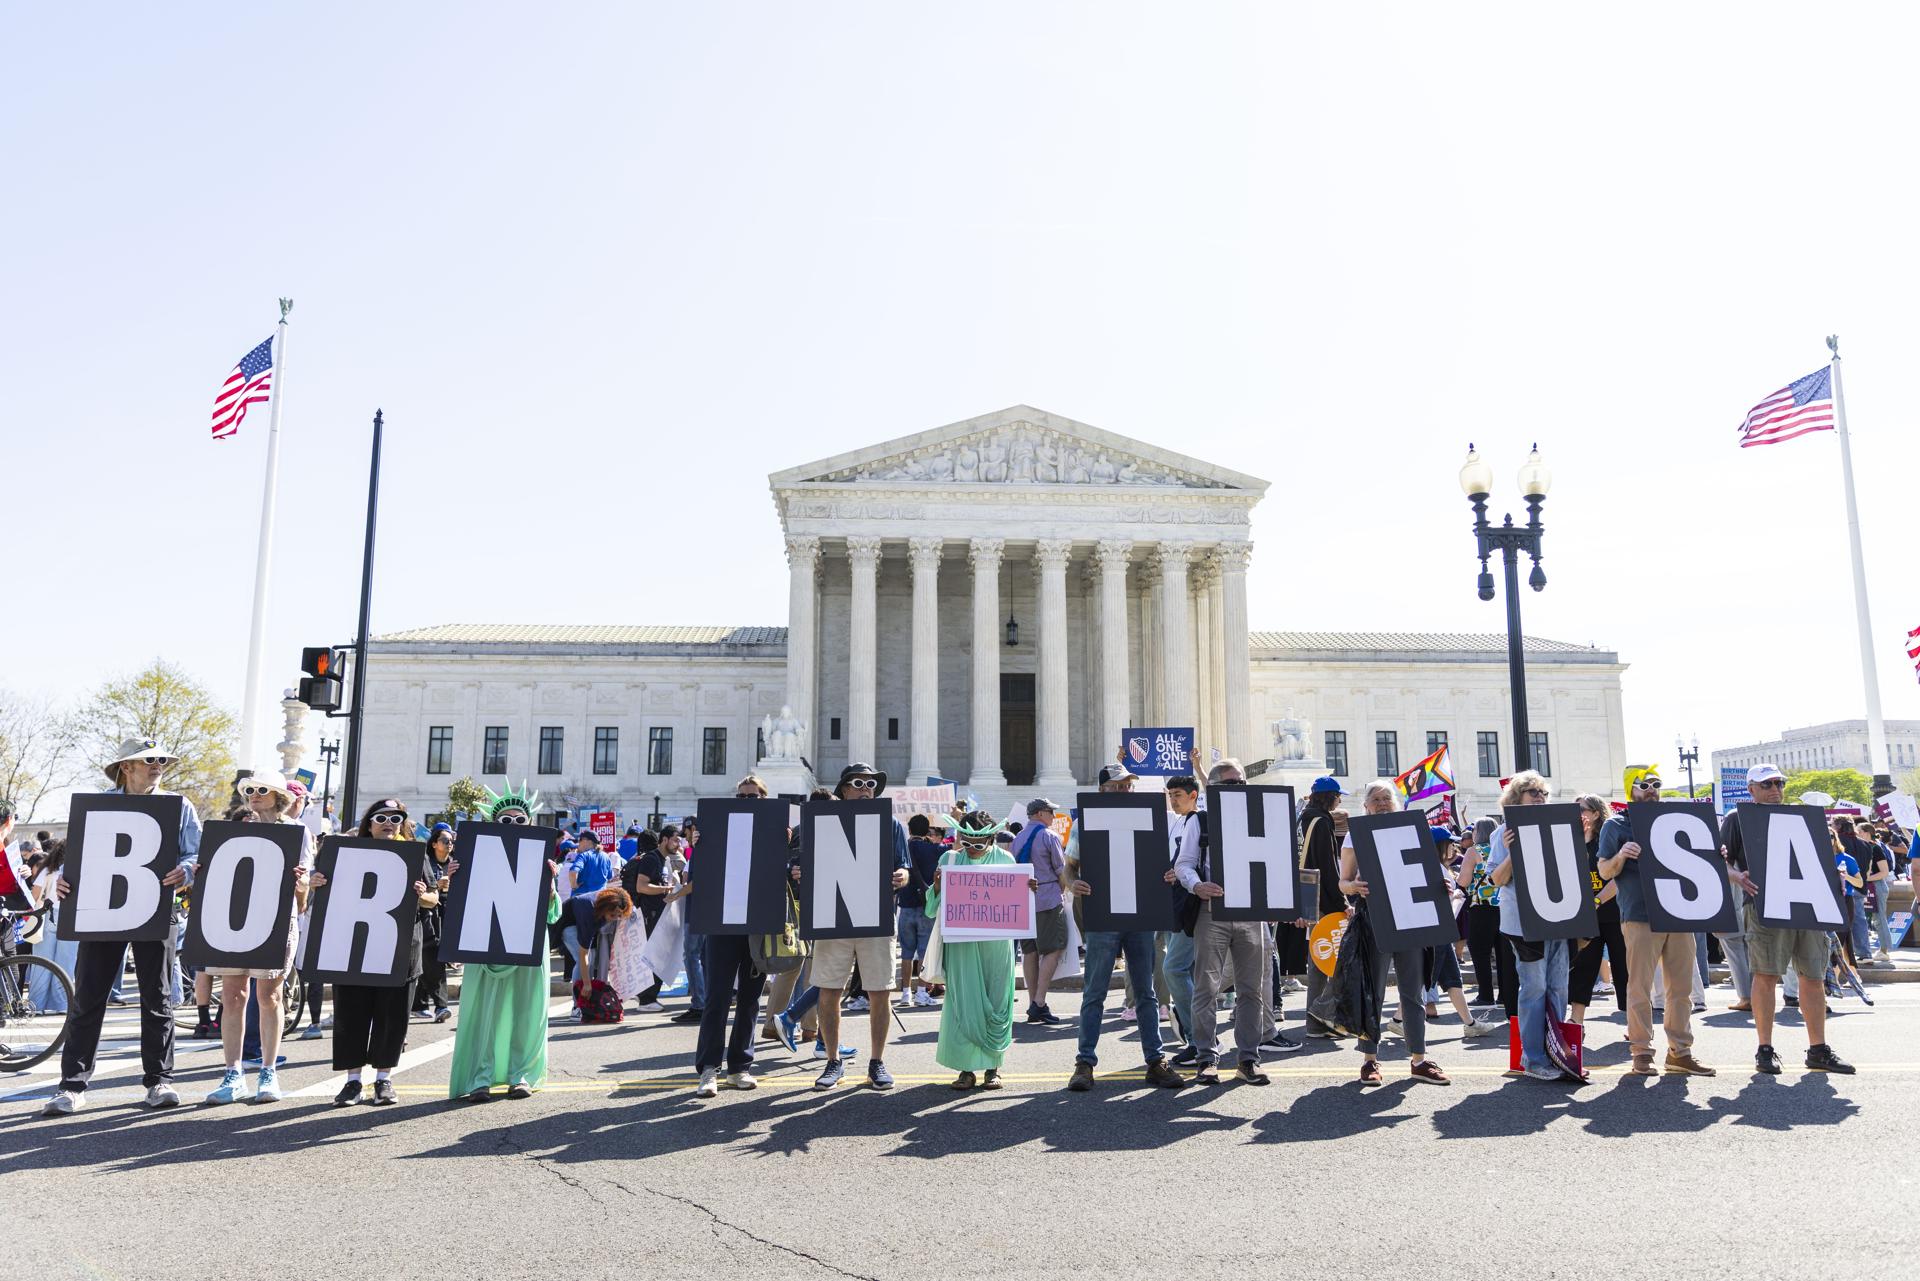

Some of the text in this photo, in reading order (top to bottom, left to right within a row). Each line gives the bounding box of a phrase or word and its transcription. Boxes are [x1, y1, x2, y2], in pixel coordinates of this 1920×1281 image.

[1156, 734, 1176, 743] ALL
[1156, 743, 1182, 752] ONE
[1162, 751, 1187, 761] ONE
[1163, 761, 1184, 770] ALL
[949, 873, 1015, 888] CITIZENSHIP
[969, 891, 991, 900] IS A
[946, 903, 1021, 923] BIRTHRIGHT
